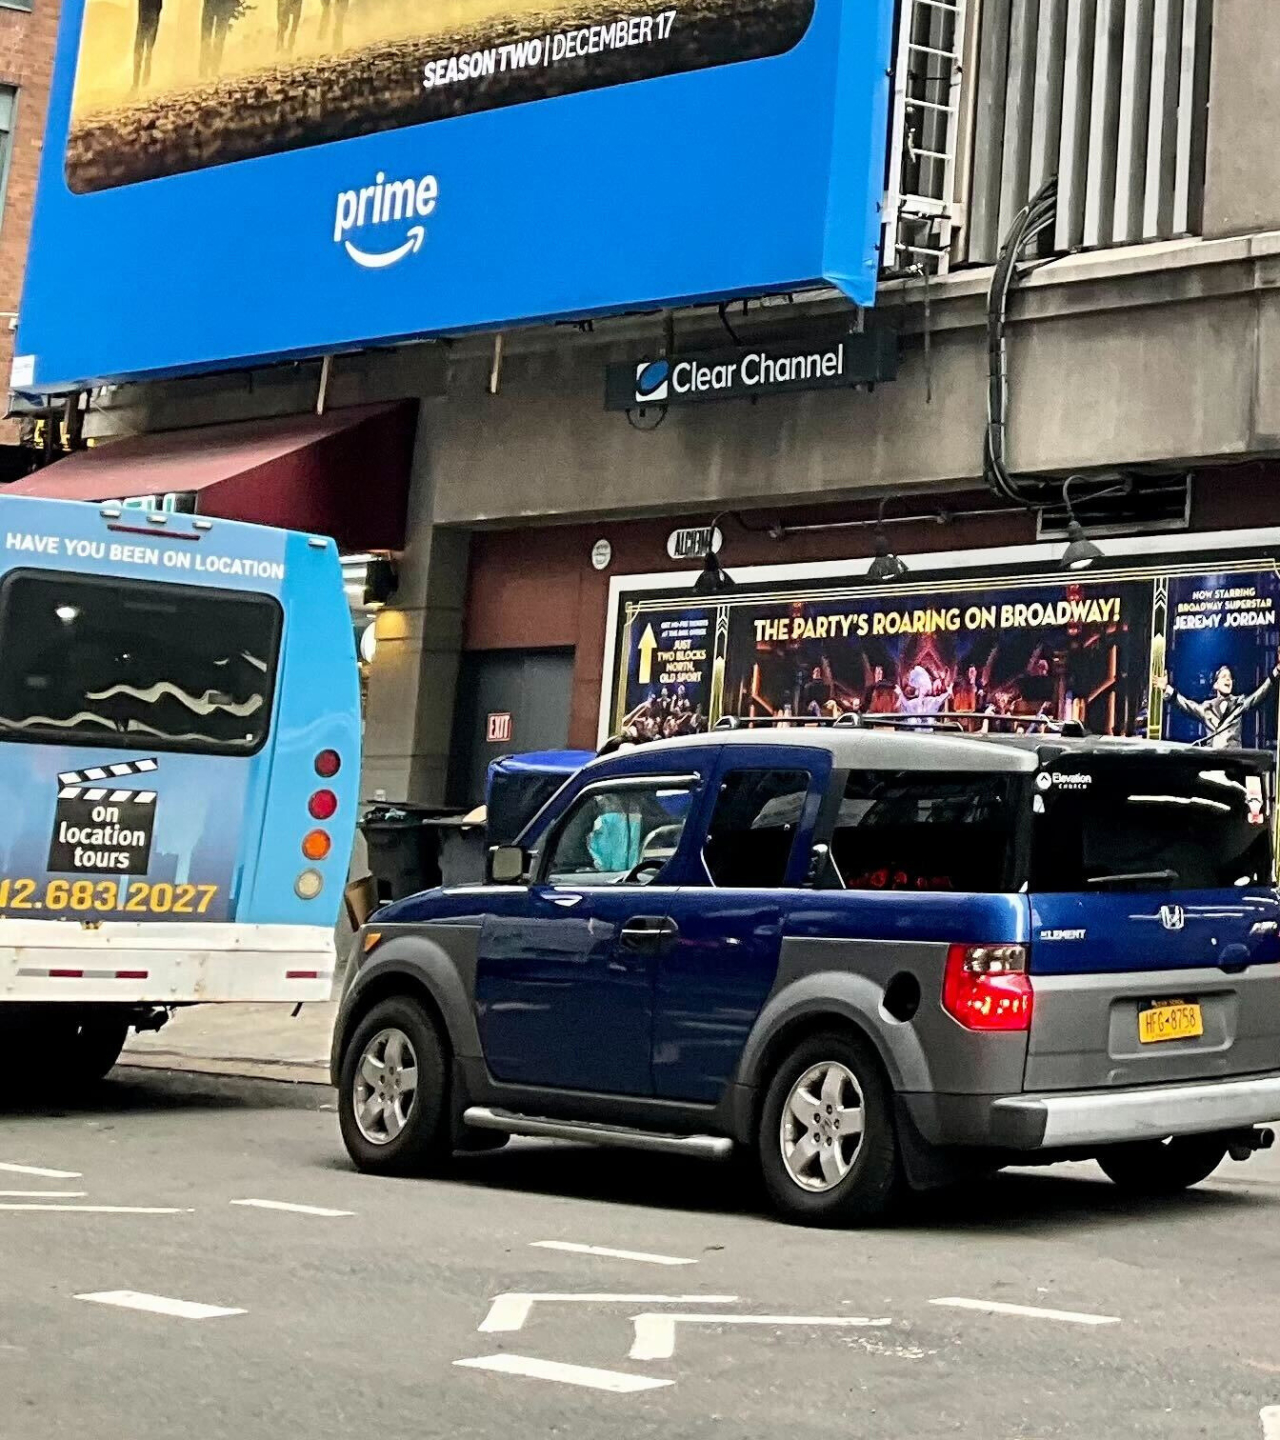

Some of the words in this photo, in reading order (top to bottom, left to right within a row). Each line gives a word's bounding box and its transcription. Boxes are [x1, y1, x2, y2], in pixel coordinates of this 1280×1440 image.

[423, 48, 496, 88] SEASON
[498, 38, 542, 72] TWO
[552, 15, 653, 61] DECEMBER
[655, 10, 677, 40] 17
[334, 171, 438, 241] prime
[672, 356, 737, 395] Clear
[740, 344, 844, 384] Channel
[6, 533, 60, 555] HAVE
[64, 538, 105, 559] YOU
[109, 544, 159, 566] BEEN
[163, 551, 191, 571] ON
[195, 555, 285, 580] LOCATION
[1192, 590, 1213, 600] NOW
[1214, 587, 1256, 599] STARRING
[1177, 601, 1223, 613] BROADWAY
[1224, 598, 1272, 610] SUPERSTAR
[754, 619, 790, 642] THE
[792, 613, 869, 640] PARTY'S
[873, 608, 961, 635] ROARING
[964, 605, 996, 631] ON
[1000, 597, 1121, 629] BROADWAY!
[1173, 613, 1222, 630] JEREMY
[1223, 610, 1276, 628] JORDAN
[657, 651, 675, 662] TWO
[676, 649, 707, 661] BLOCKS
[673, 639, 692, 650] JUST
[660, 672, 676, 683] OLD
[677, 671, 702, 683] SPORT
[489, 715, 510, 739] EXIT
[1052, 772, 1092, 784] Elevation
[91, 805, 120, 823] on
[59, 821, 146, 847] location
[73, 846, 130, 870] tours
